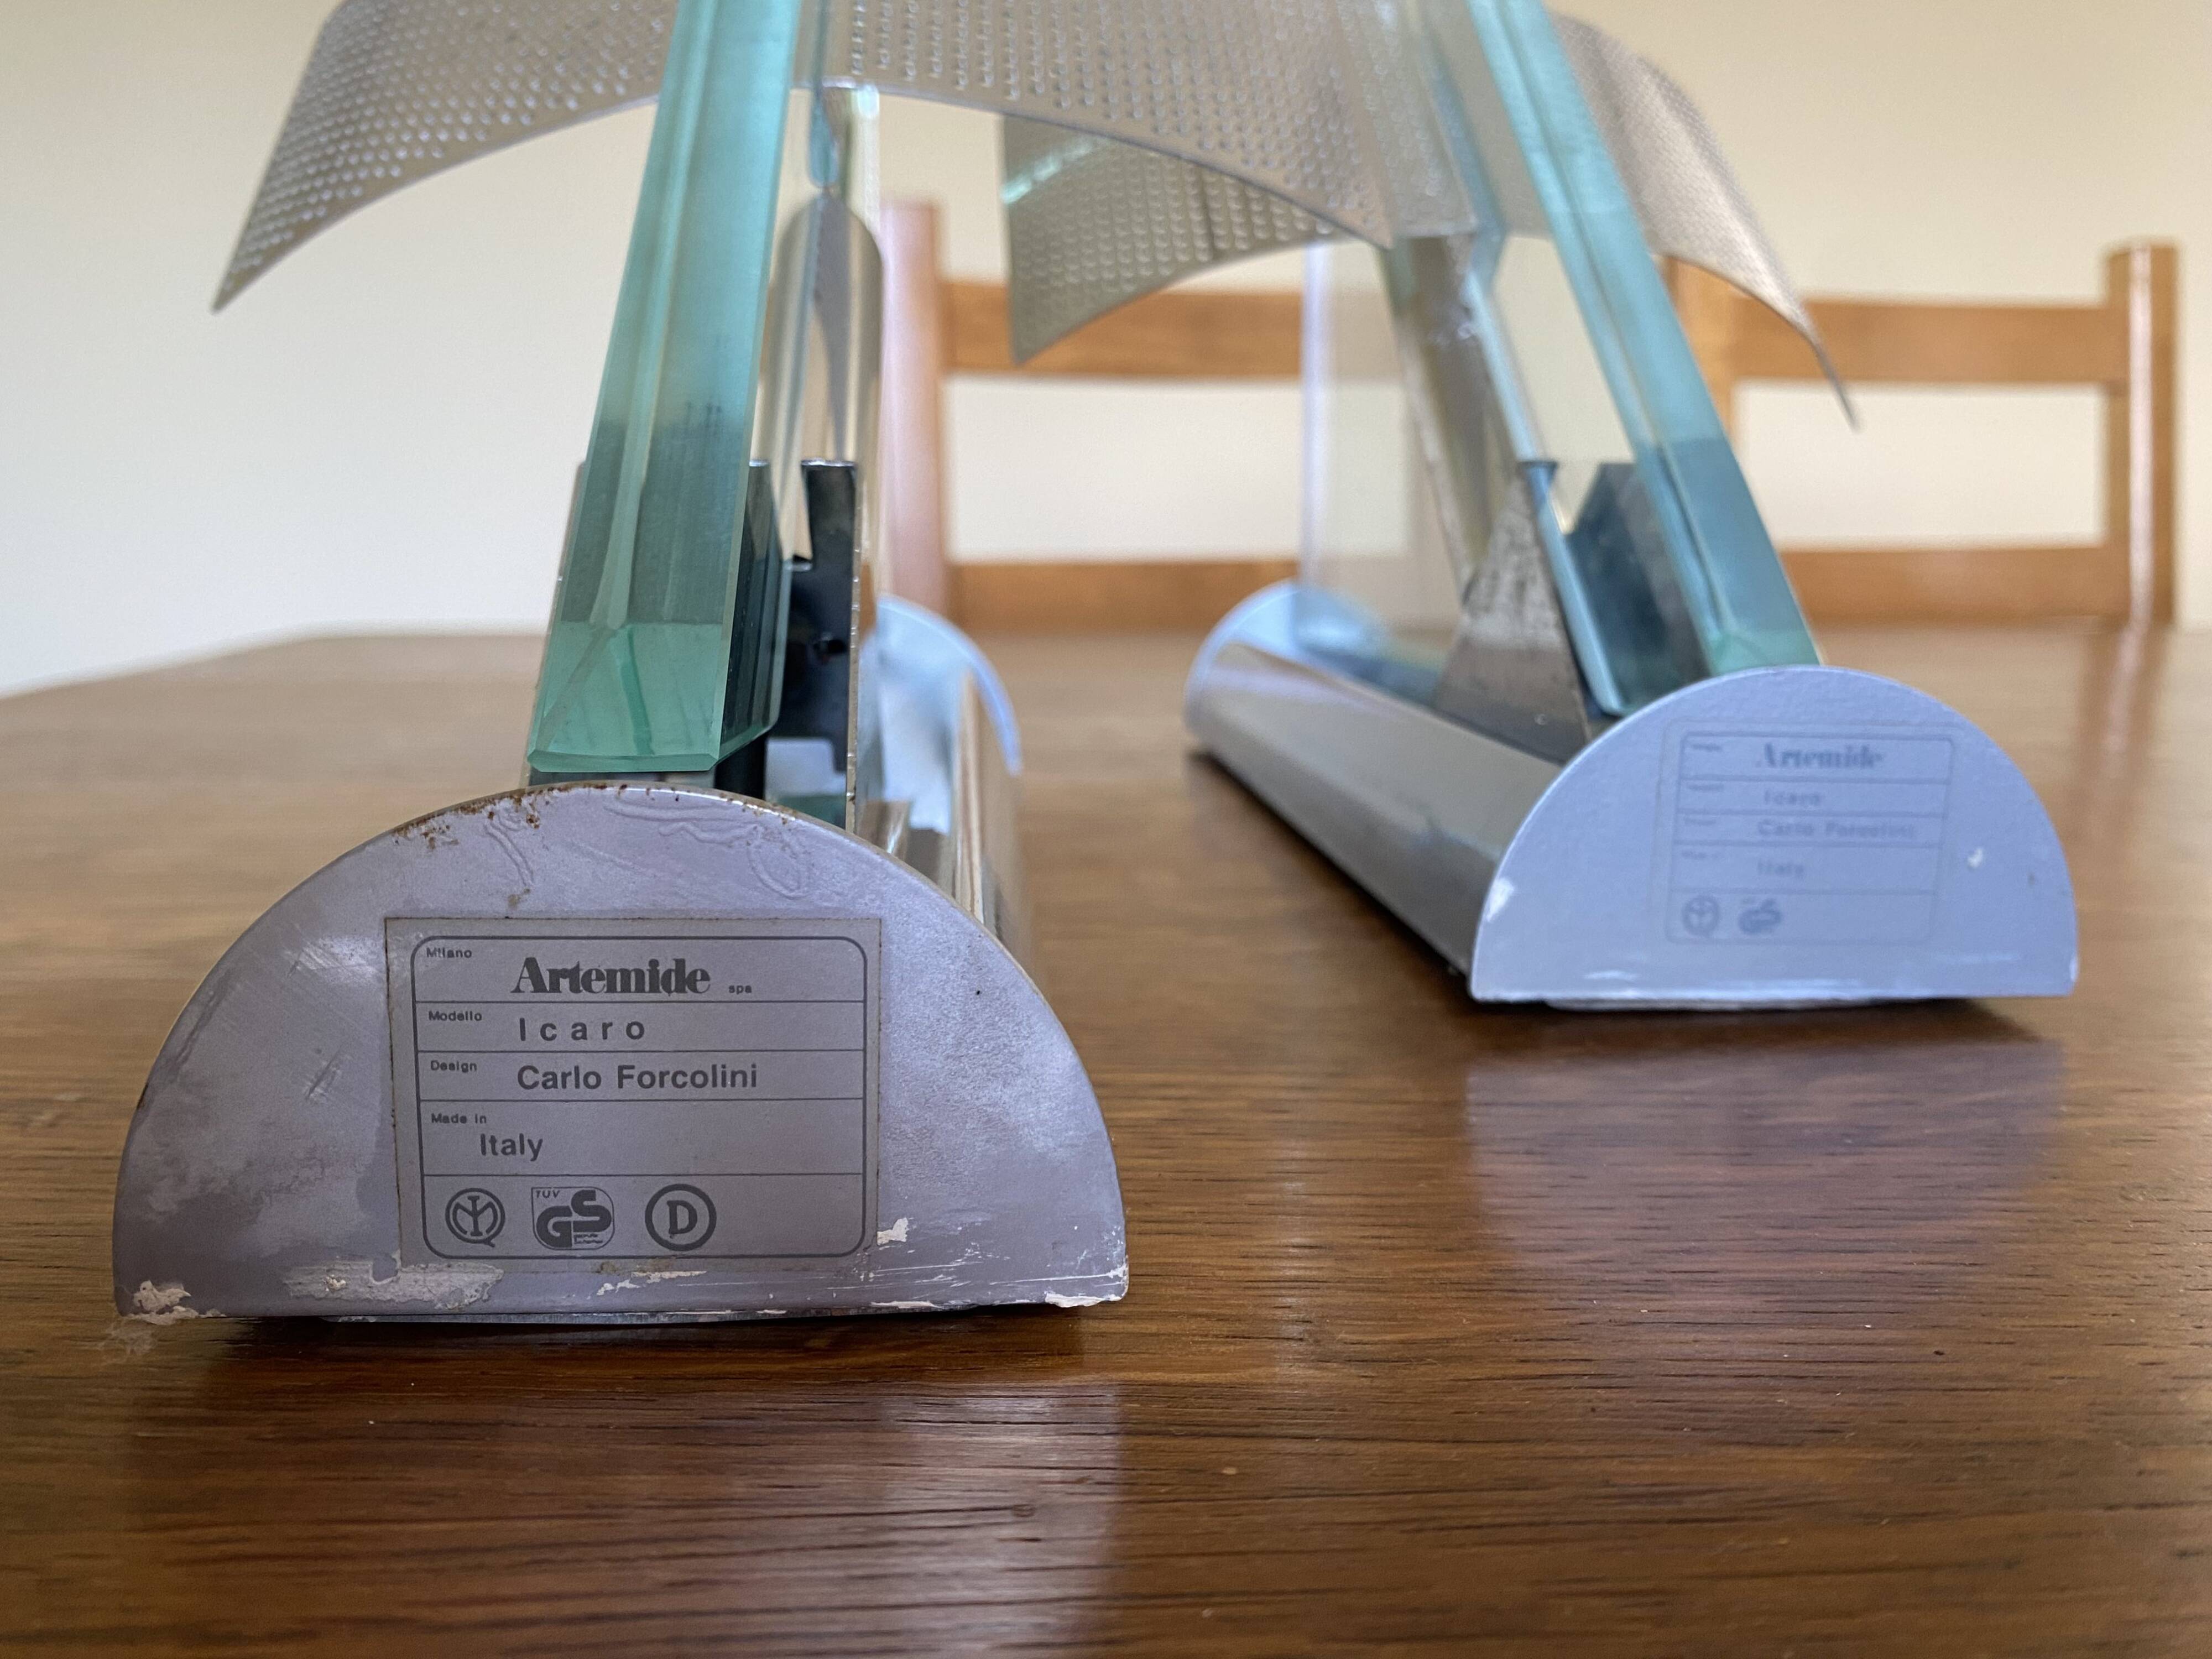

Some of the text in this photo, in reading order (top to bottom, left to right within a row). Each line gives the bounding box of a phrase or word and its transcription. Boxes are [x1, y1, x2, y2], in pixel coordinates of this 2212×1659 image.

[426, 947, 472, 958] Milano
[511, 957, 752, 996] Artemide spa
[429, 1011, 482, 1021] Modello
[520, 1018, 645, 1041] Icaro
[431, 1060, 477, 1073] Design
[517, 1065, 758, 1090] Carlo Forcolini
[431, 1113, 467, 1124] Made
[481, 1133, 543, 1161] Italy
